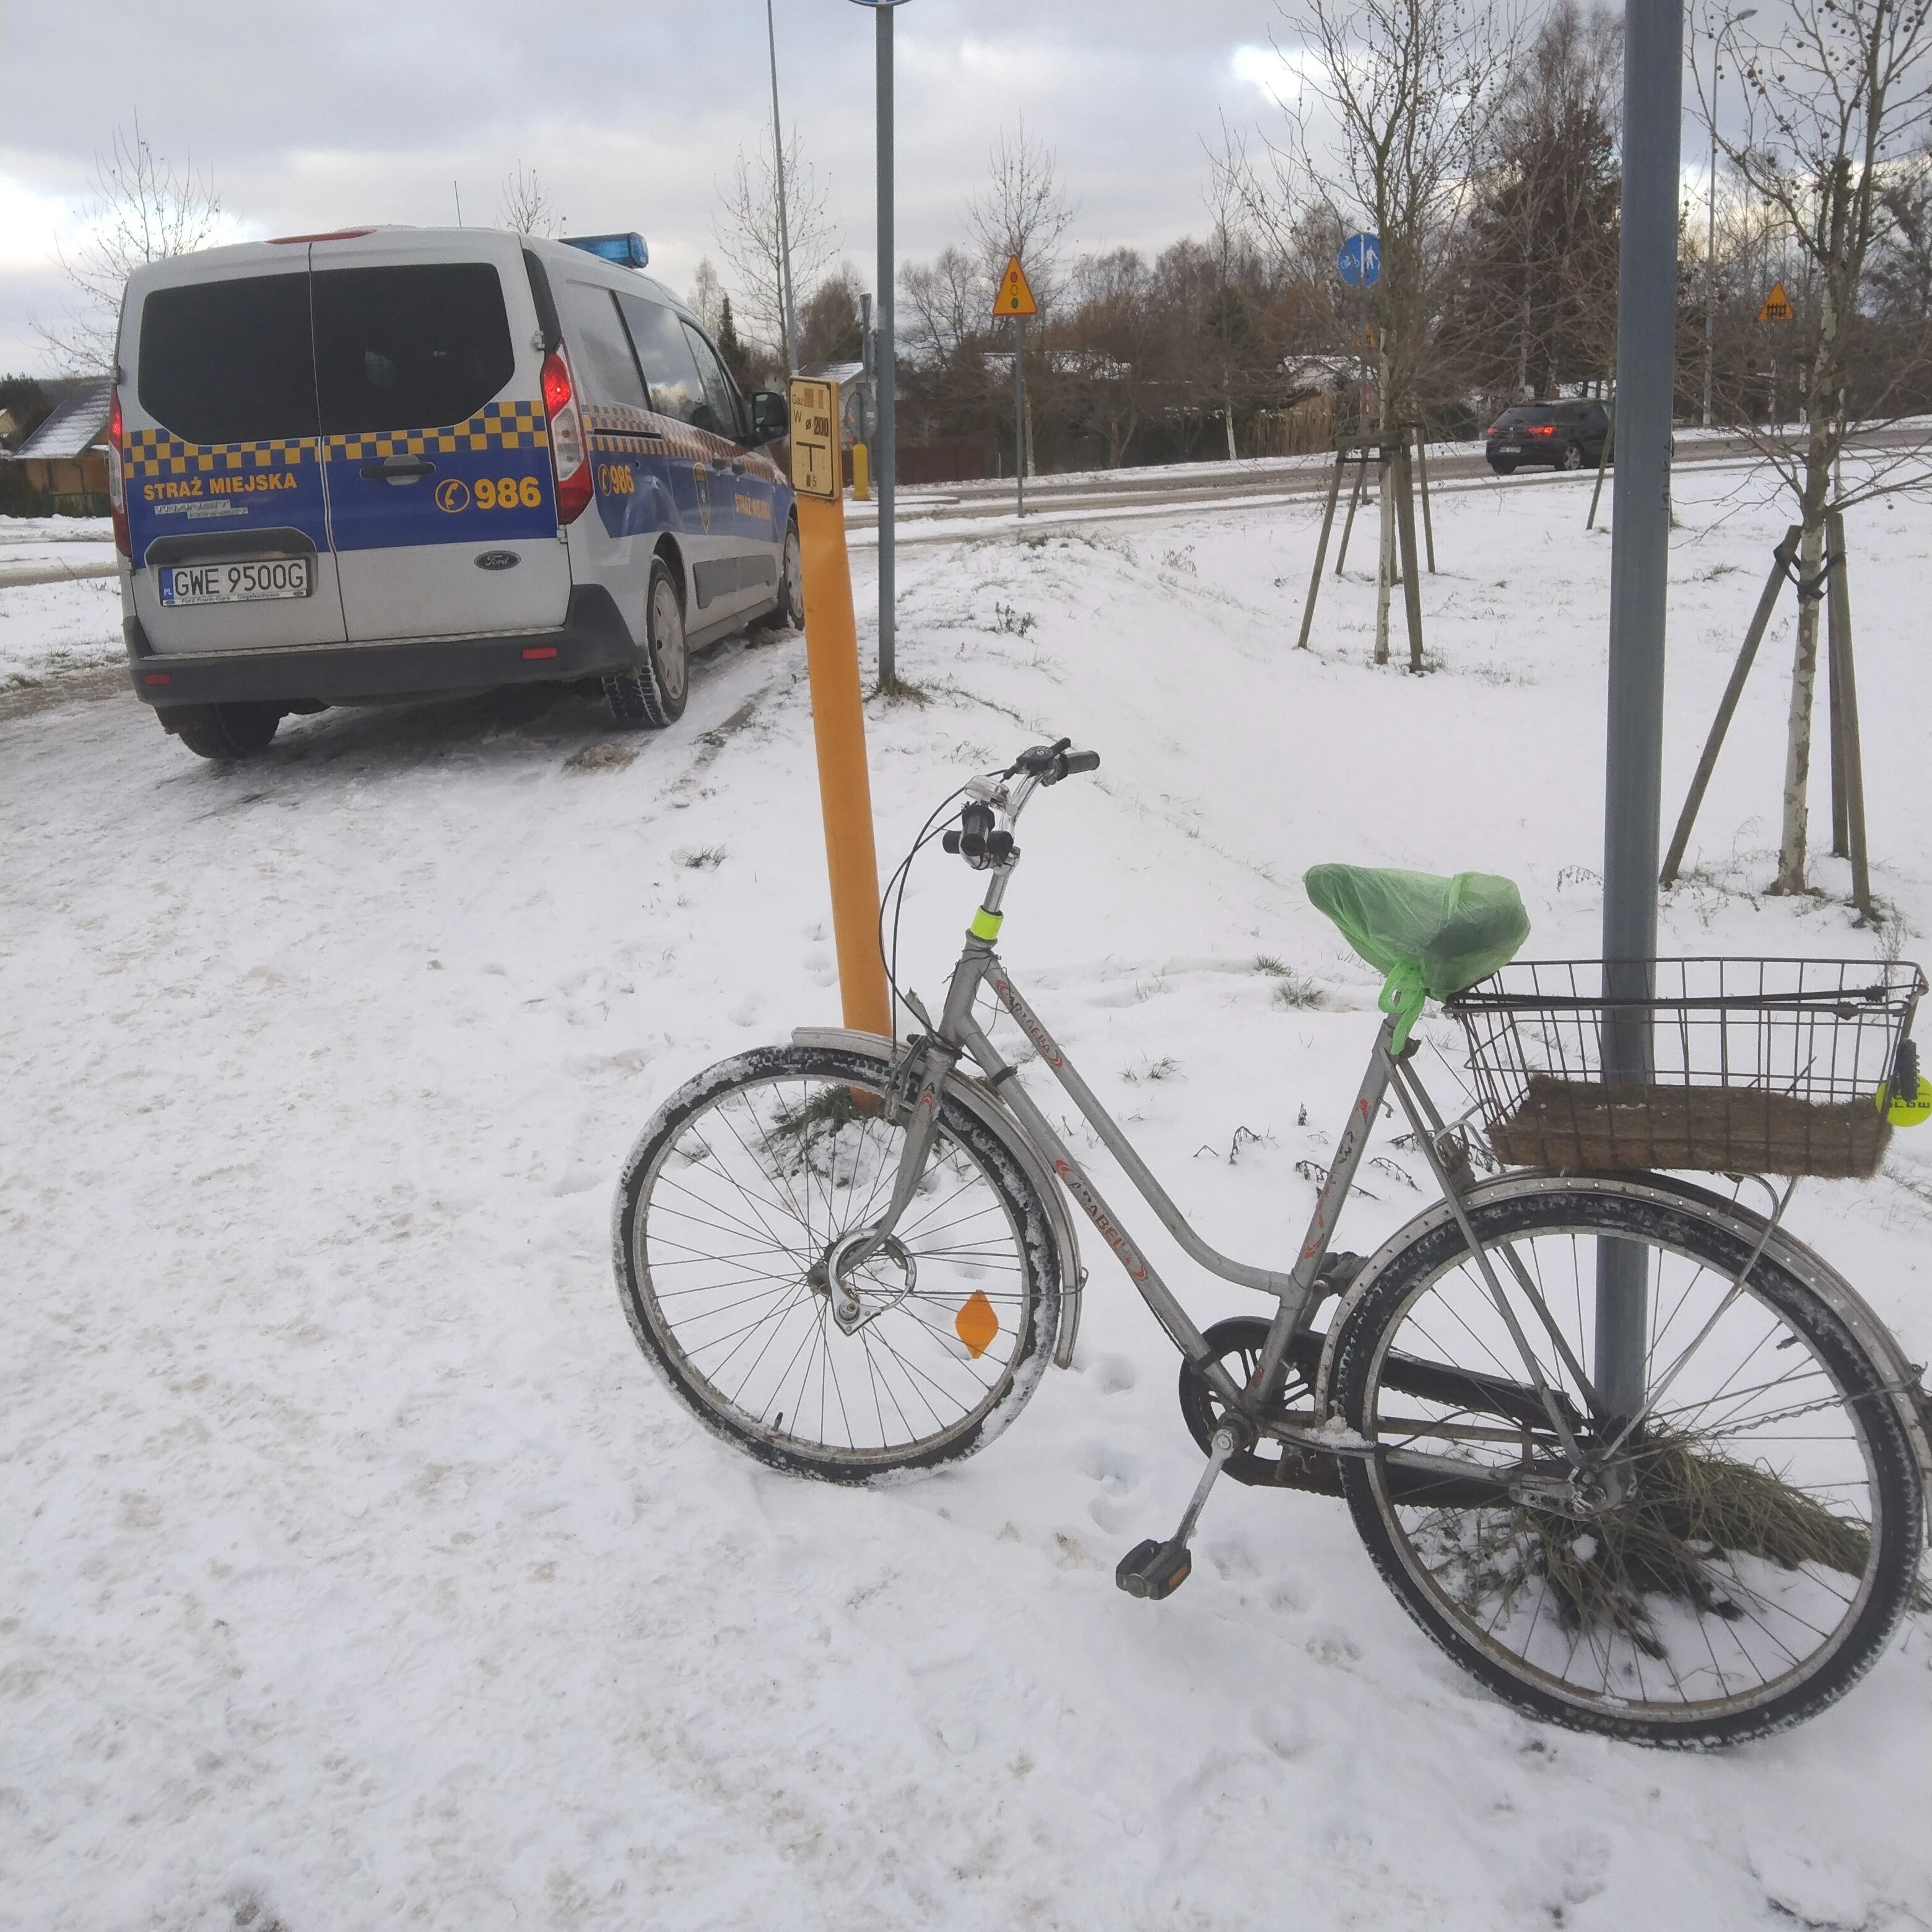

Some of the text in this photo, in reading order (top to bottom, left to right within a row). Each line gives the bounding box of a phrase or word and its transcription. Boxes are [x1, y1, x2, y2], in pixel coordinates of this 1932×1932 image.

[792, 394, 804, 405] Gaz
[793, 409, 802, 423] W
[813, 416, 829, 437] 200
[144, 472, 297, 501] STRAŻ MIEJSKA
[610, 465, 635, 494] 986
[474, 476, 541, 510] 986
[485, 555, 509, 566] Ford
[175, 563, 303, 596] GWE 9500G
